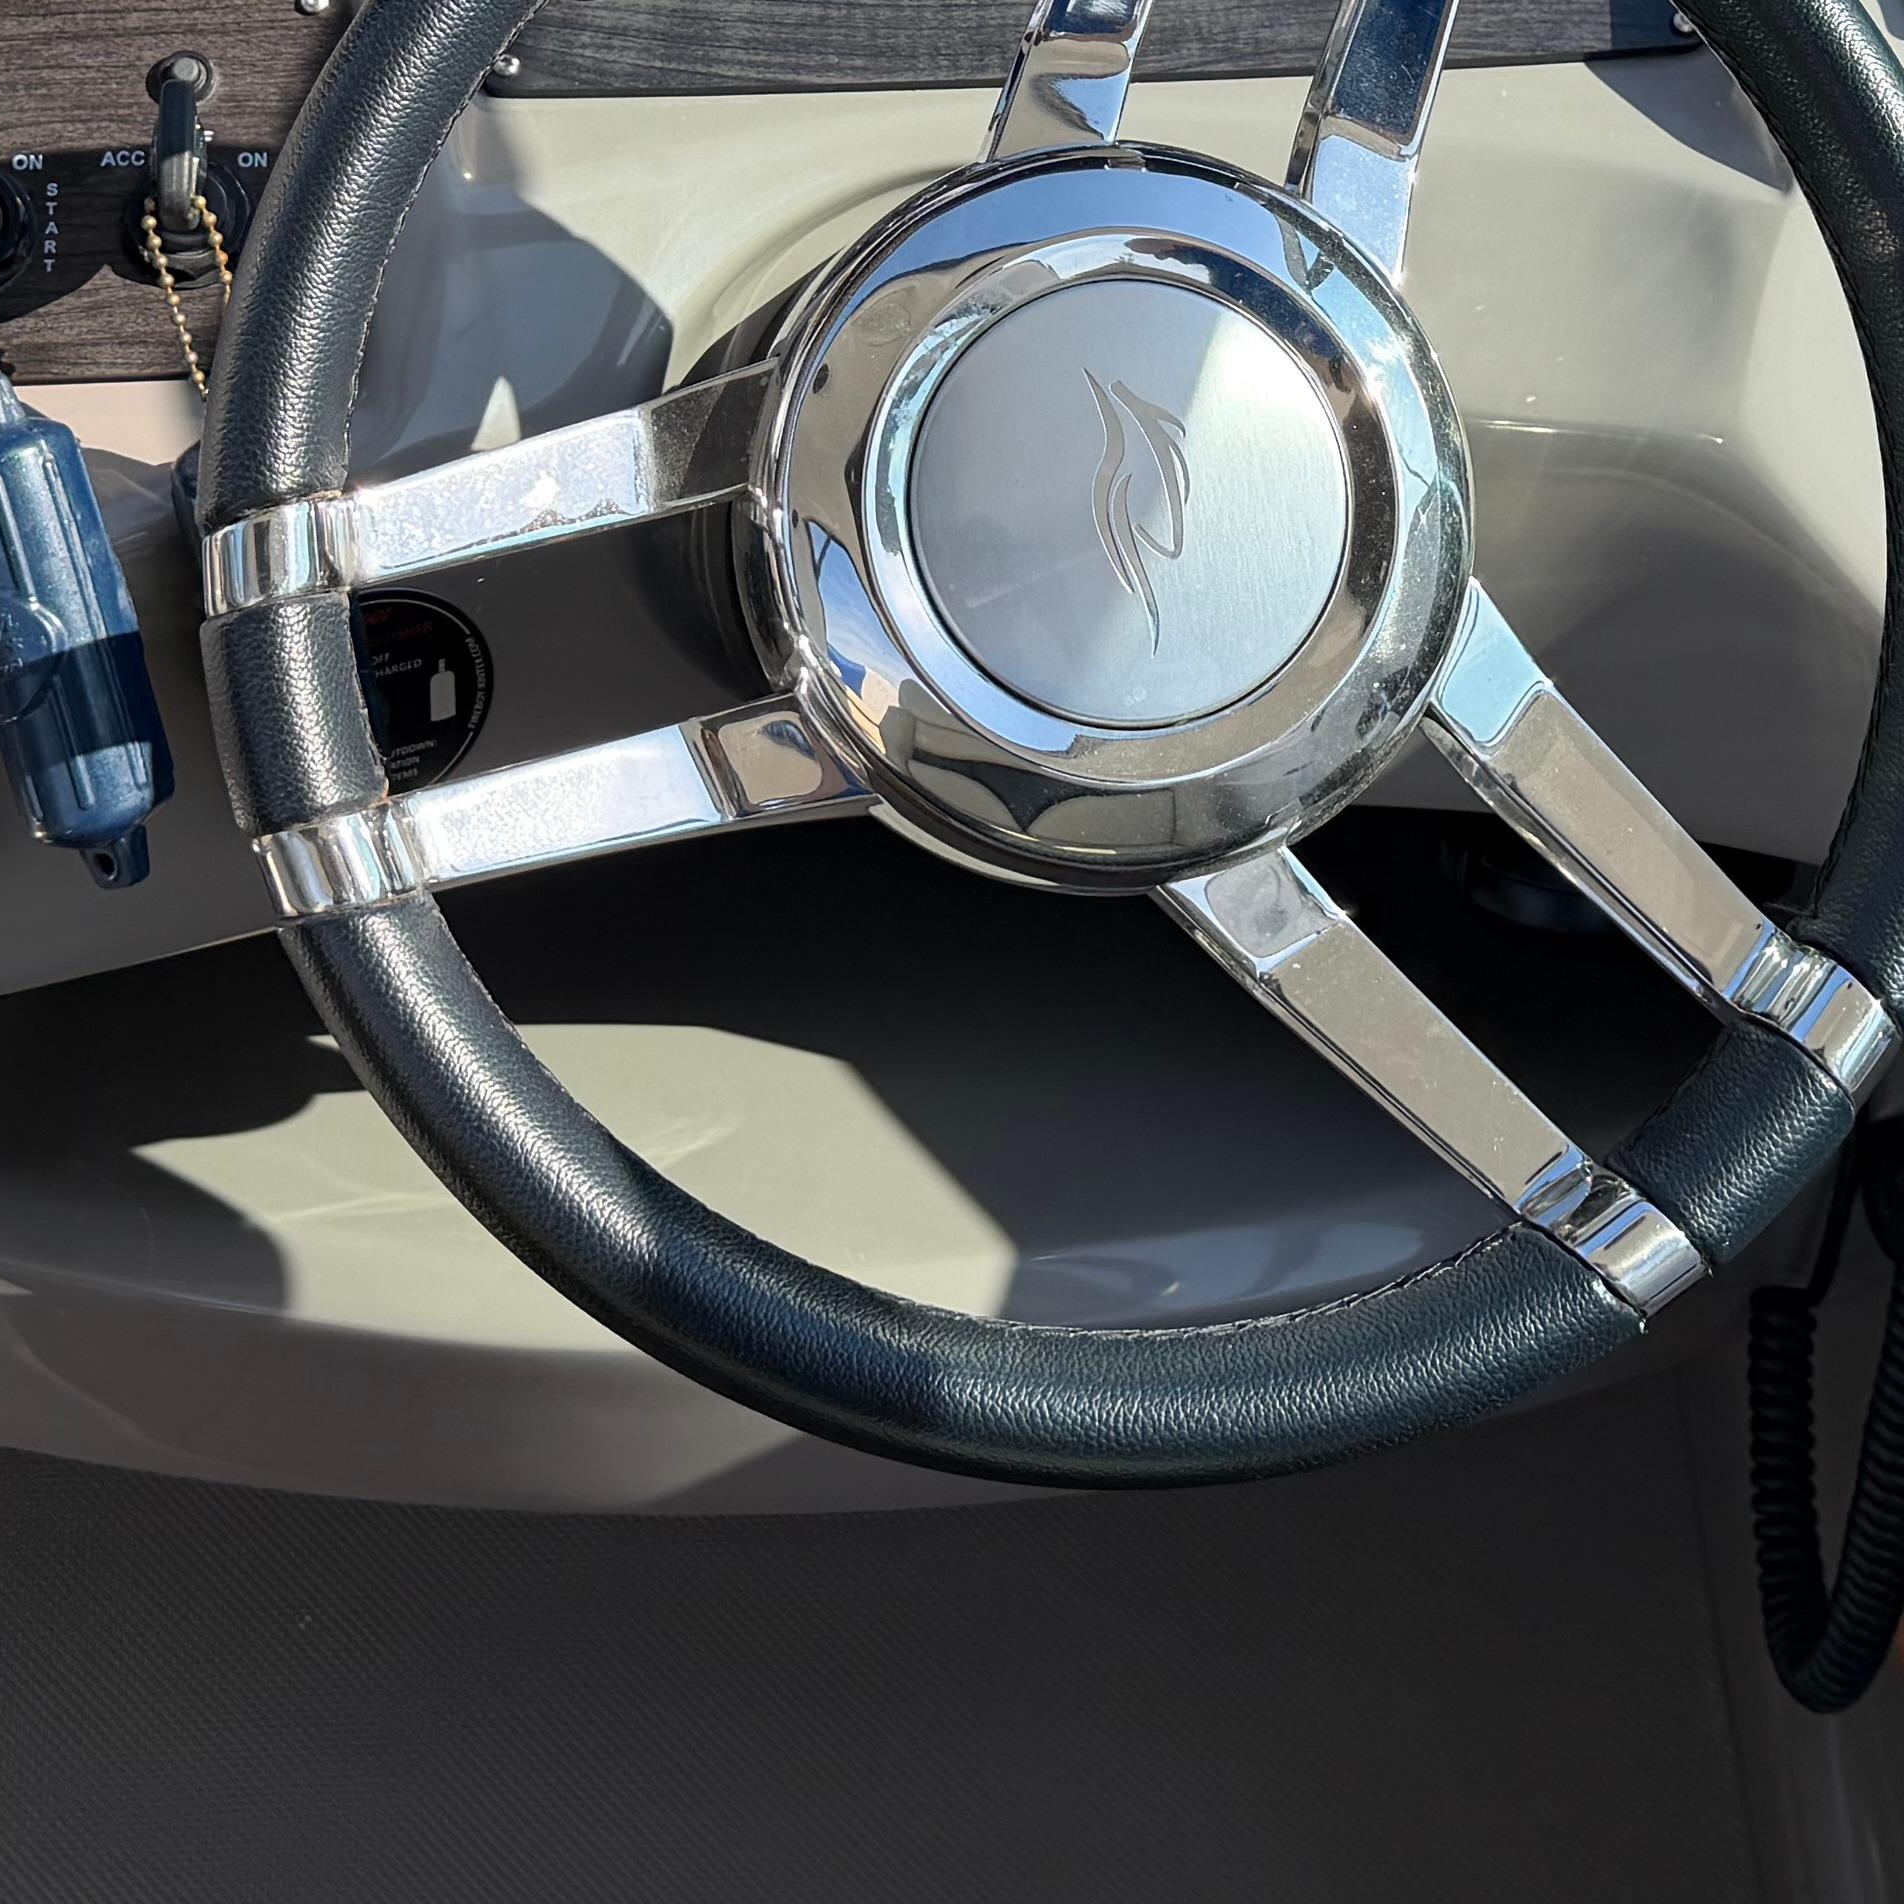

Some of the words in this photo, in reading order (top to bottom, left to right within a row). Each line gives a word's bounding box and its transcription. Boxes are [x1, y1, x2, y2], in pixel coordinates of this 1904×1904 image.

[12, 154, 44, 171] ON
[100, 150, 146, 167] ACC
[237, 151, 268, 168] ON
[43, 183, 59, 273] START
